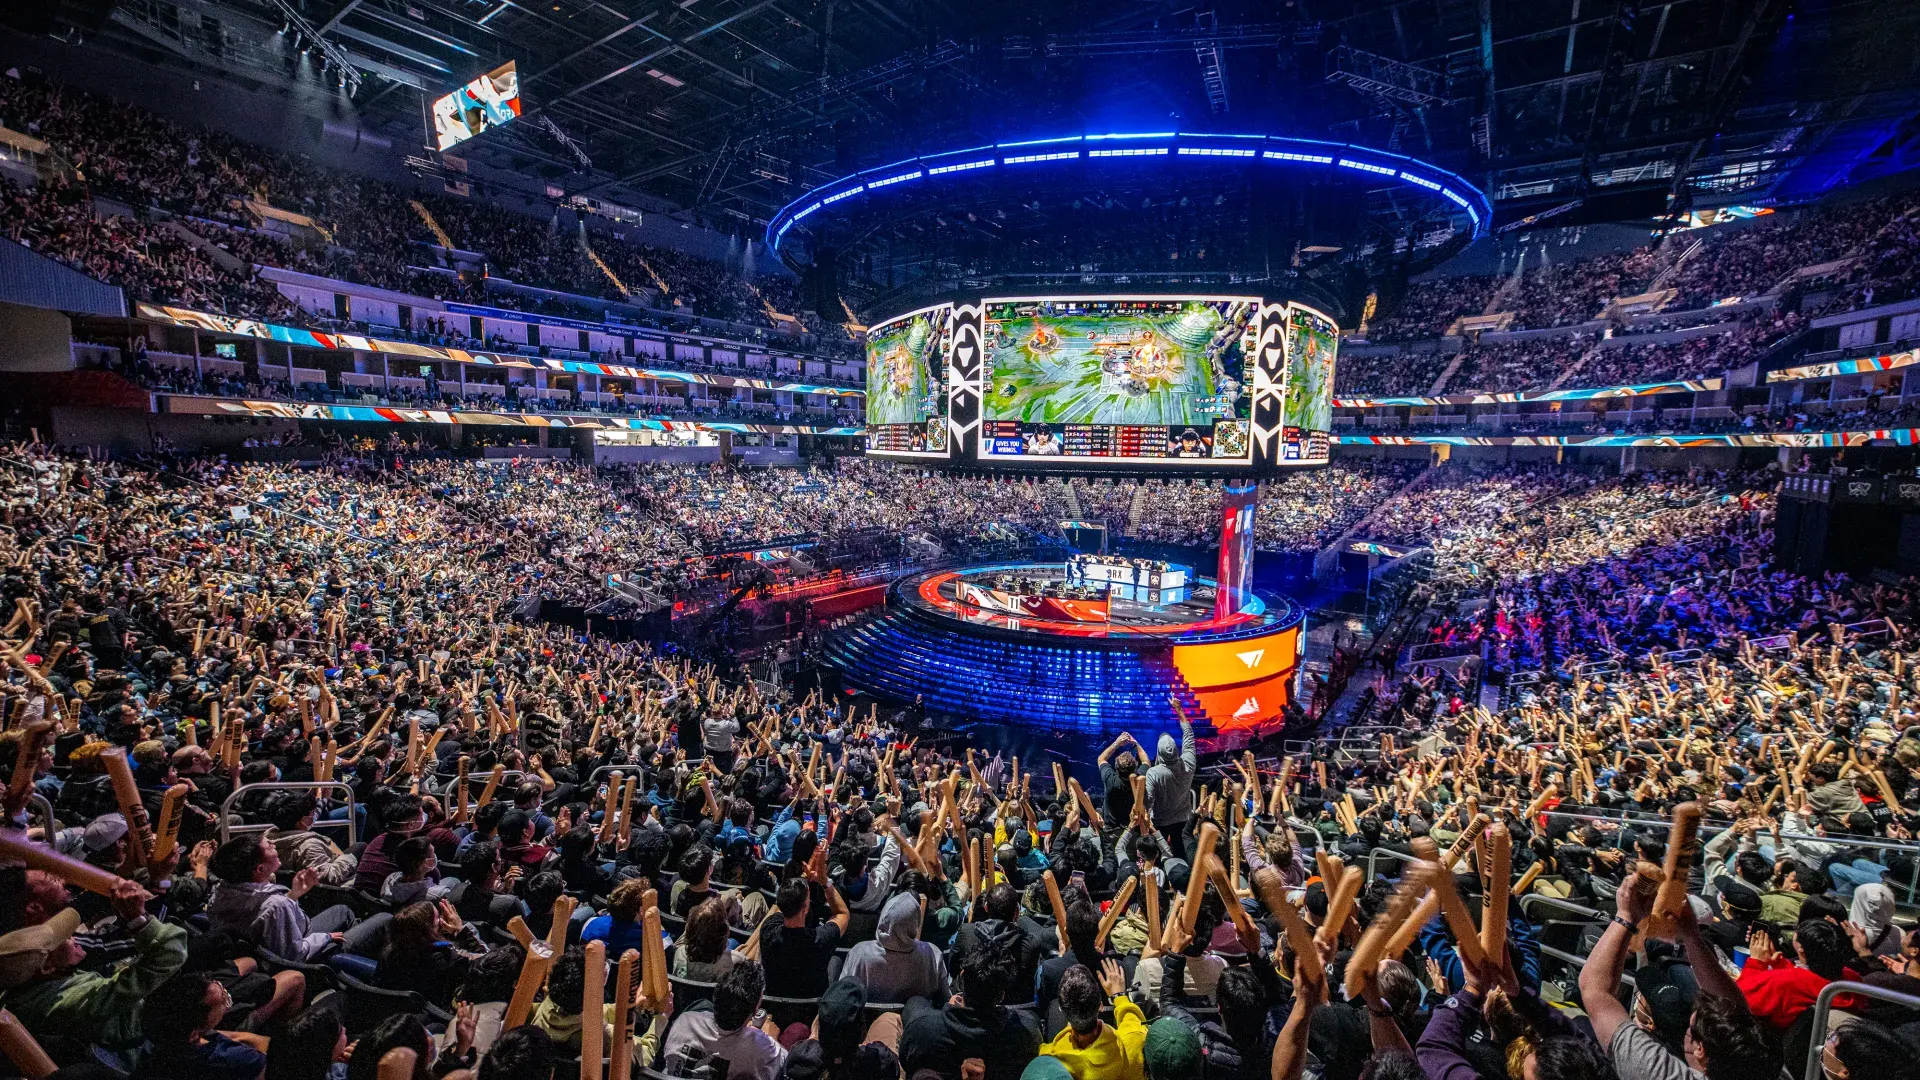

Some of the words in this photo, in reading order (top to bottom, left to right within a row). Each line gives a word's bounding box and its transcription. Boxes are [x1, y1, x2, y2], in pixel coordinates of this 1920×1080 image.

[608, 327, 622, 335] Google
[1009, 597, 1019, 610] T1
[1465, 817, 1488, 841] WORLDS
